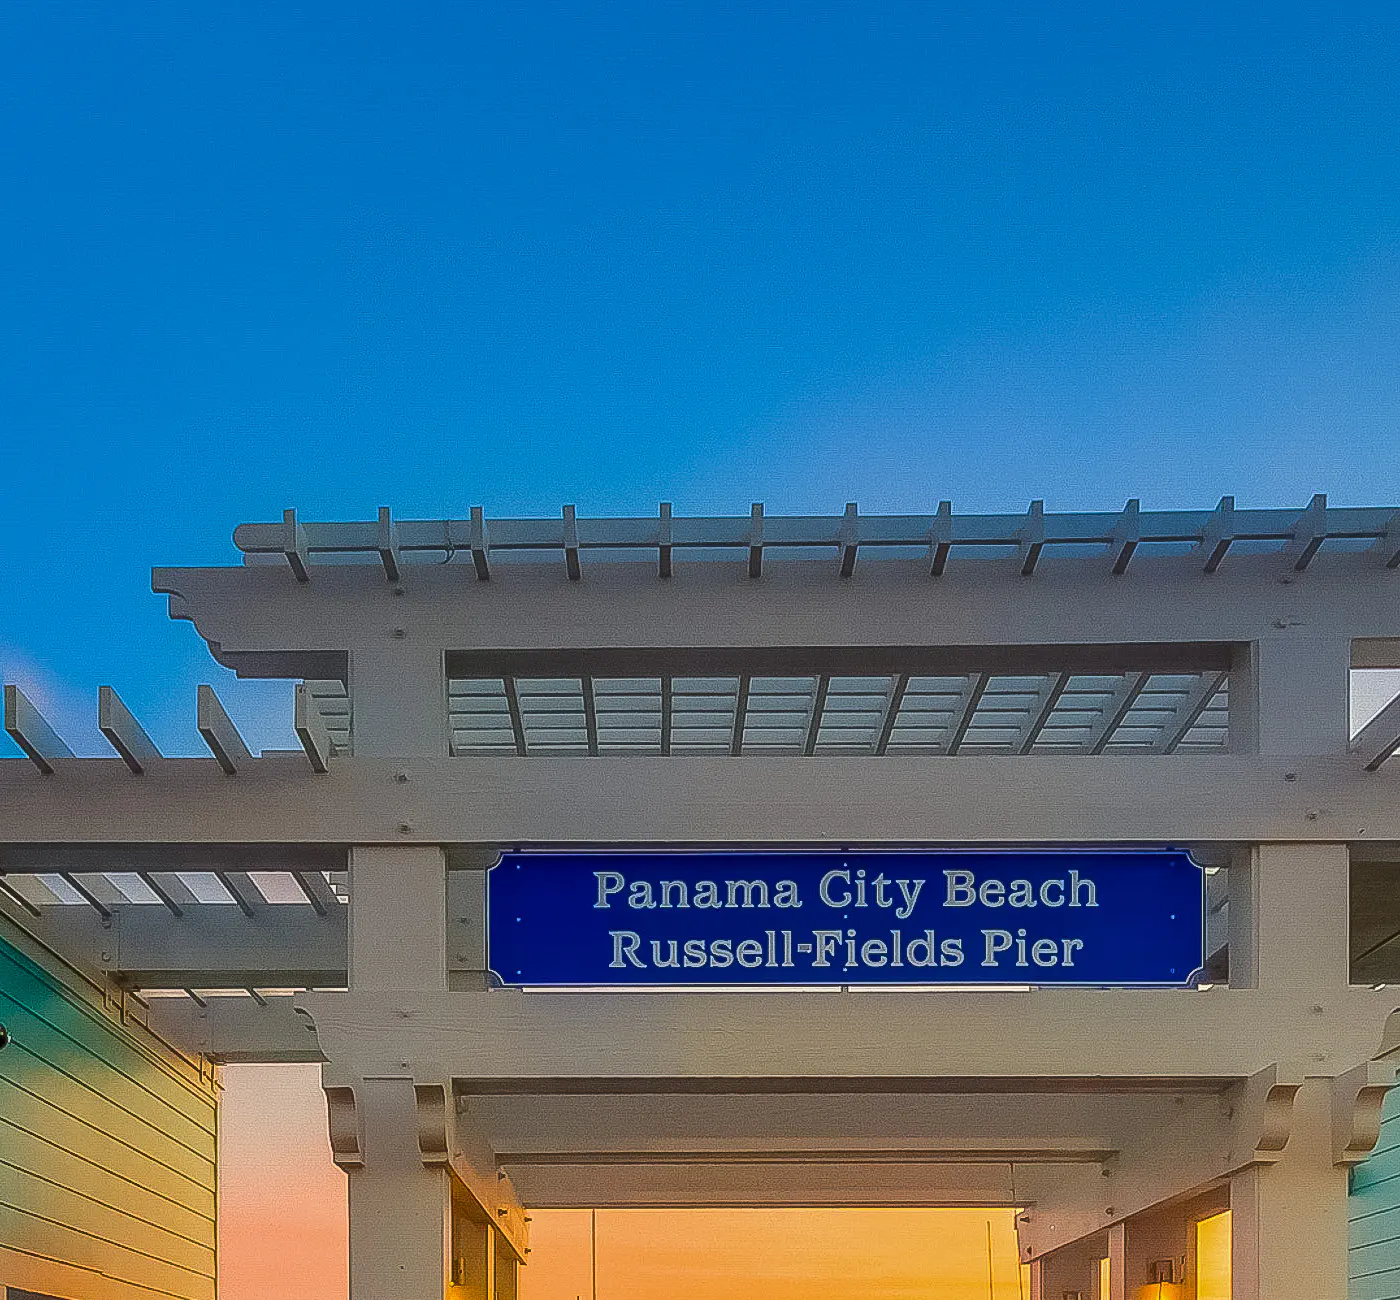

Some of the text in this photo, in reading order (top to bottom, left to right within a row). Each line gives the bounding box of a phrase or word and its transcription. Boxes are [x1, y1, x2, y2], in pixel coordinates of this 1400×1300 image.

[592, 869, 1100, 919] Panama City Beach
[608, 929, 1084, 969] Russell-Fields Pier
